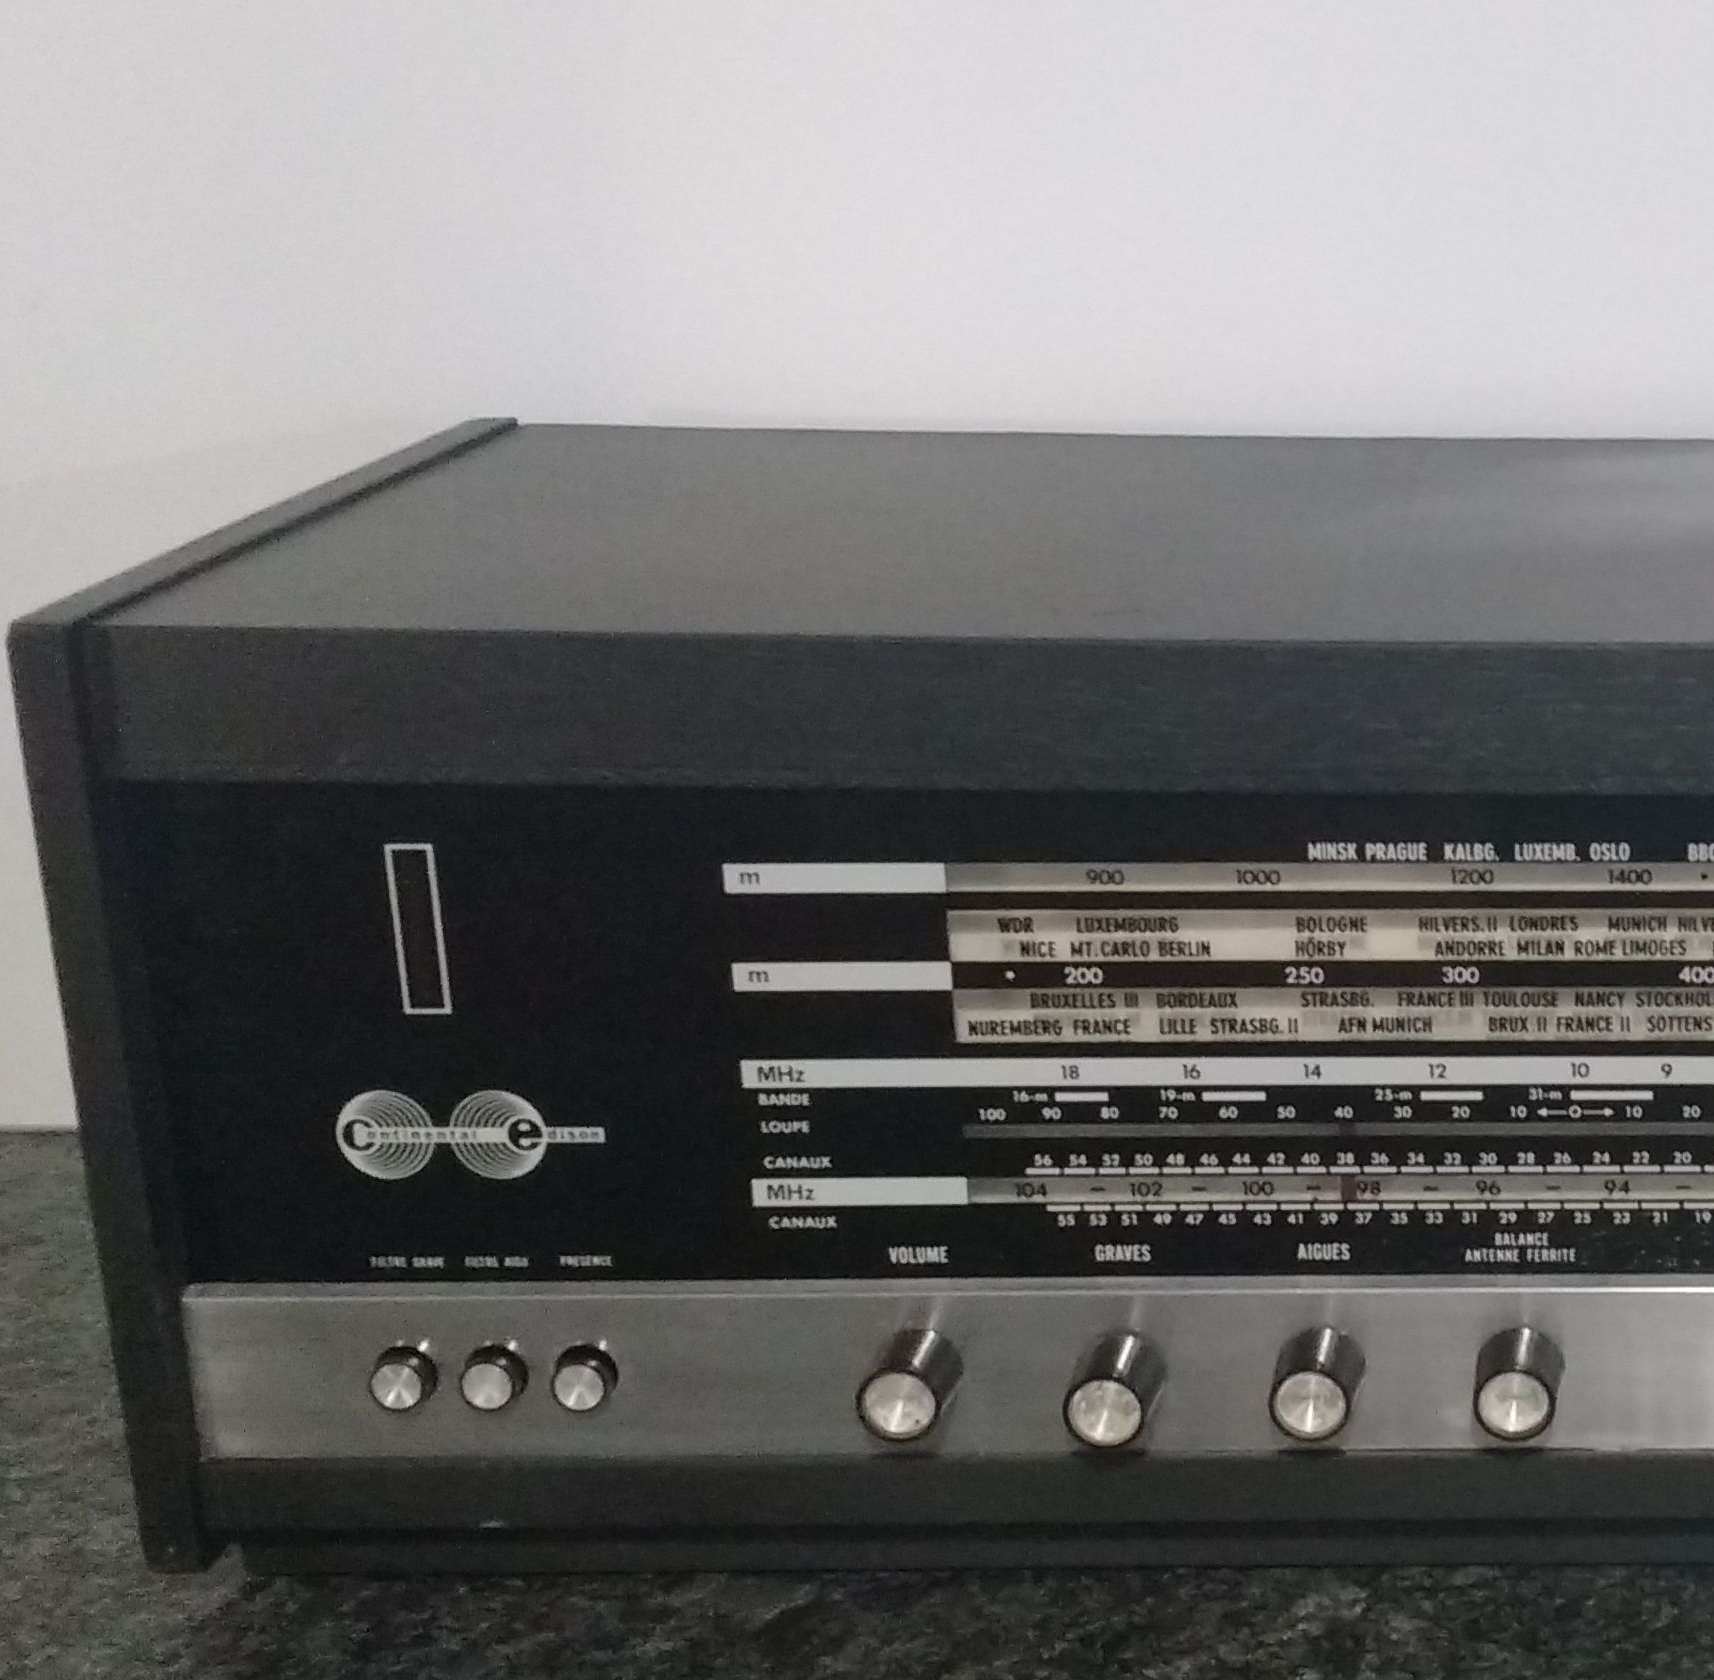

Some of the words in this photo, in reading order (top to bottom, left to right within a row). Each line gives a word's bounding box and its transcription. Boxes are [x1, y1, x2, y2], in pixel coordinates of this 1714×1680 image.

[1308, 843, 1357, 860] MINSK
[1365, 843, 1427, 860] PRAGUE
[1590, 843, 1630, 861] OSLO
[740, 872, 759, 884] m
[1086, 869, 1124, 885] 900
[1236, 870, 1280, 885] 1000
[1452, 869, 1494, 885] 1200
[1609, 869, 1652, 885] 1400
[997, 917, 1033, 933] WDR
[1077, 917, 1178, 934] LUXEMBOURG
[1296, 917, 1366, 933] BOLOGNE
[1510, 916, 1578, 932] LONDRES
[1608, 917, 1667, 932] MUNICH
[1019, 940, 1055, 957] NICE
[1158, 939, 1210, 957] BERLIN
[1435, 940, 1503, 956] ANDORRE
[1517, 940, 1564, 956] MILAN
[1574, 939, 1615, 956] ROME
[1622, 940, 1686, 956] LIMOGES
[749, 971, 769, 982] m
[1065, 967, 1103, 984] 200
[1285, 967, 1324, 984] 250
[1442, 967, 1479, 983] 300
[1030, 993, 1116, 1008] BRUXELLES
[1124, 993, 1139, 1008] III
[1157, 992, 1237, 1008] BORDEAUX
[1398, 991, 1454, 1007] FRANCE
[1460, 992, 1474, 1007] III
[1484, 991, 1558, 1008] TOULOUSE
[1575, 992, 1624, 1007] NANCY
[1073, 1019, 1130, 1035] FRANCE
[1160, 1019, 1196, 1035] LILLE
[1288, 1018, 1298, 1033] II
[1338, 1017, 1366, 1033] AFN
[1372, 1014, 1432, 1033] MUNICH
[1537, 1017, 1547, 1032] II
[1557, 1016, 1613, 1032] FRANCE
[1620, 1016, 1630, 1032] II
[1648, 1016, 1712, 1032] SOTTENS
[757, 1066, 804, 1082] MHz
[1061, 1065, 1080, 1079] 18
[1183, 1064, 1201, 1079] 16
[1304, 1064, 1321, 1079] 14
[1429, 1064, 1446, 1078] 12
[1572, 1063, 1590, 1078] 10
[1661, 1064, 1672, 1077] 9
[758, 1094, 809, 1105] BANDE
[979, 1109, 1006, 1120] 100
[1160, 1107, 1178, 1119] 70
[1219, 1106, 1238, 1118] 60
[1335, 1106, 1353, 1118] 40
[1511, 1106, 1527, 1118] 10
[1627, 1106, 1642, 1118] 10
[1683, 1105, 1701, 1118] 20
[761, 1121, 809, 1133] LOUPE
[764, 1157, 831, 1168] CANAUX
[767, 1184, 813, 1200] MHz
[1013, 1183, 1047, 1199] 104
[1131, 1182, 1162, 1198] 102
[1244, 1181, 1274, 1196] 100
[1357, 1180, 1381, 1196] 98
[1476, 1180, 1501, 1196] 96
[1604, 1180, 1630, 1195] 94
[769, 1217, 837, 1228] CANAUX
[1495, 1233, 1548, 1246] BALANCE
[889, 1247, 948, 1263] VOLUME
[1095, 1245, 1151, 1261] GRAVES
[1298, 1243, 1350, 1260] AIGUES
[1465, 1249, 1519, 1262] ANTENNE
[1527, 1249, 1575, 1262] FERRITE
